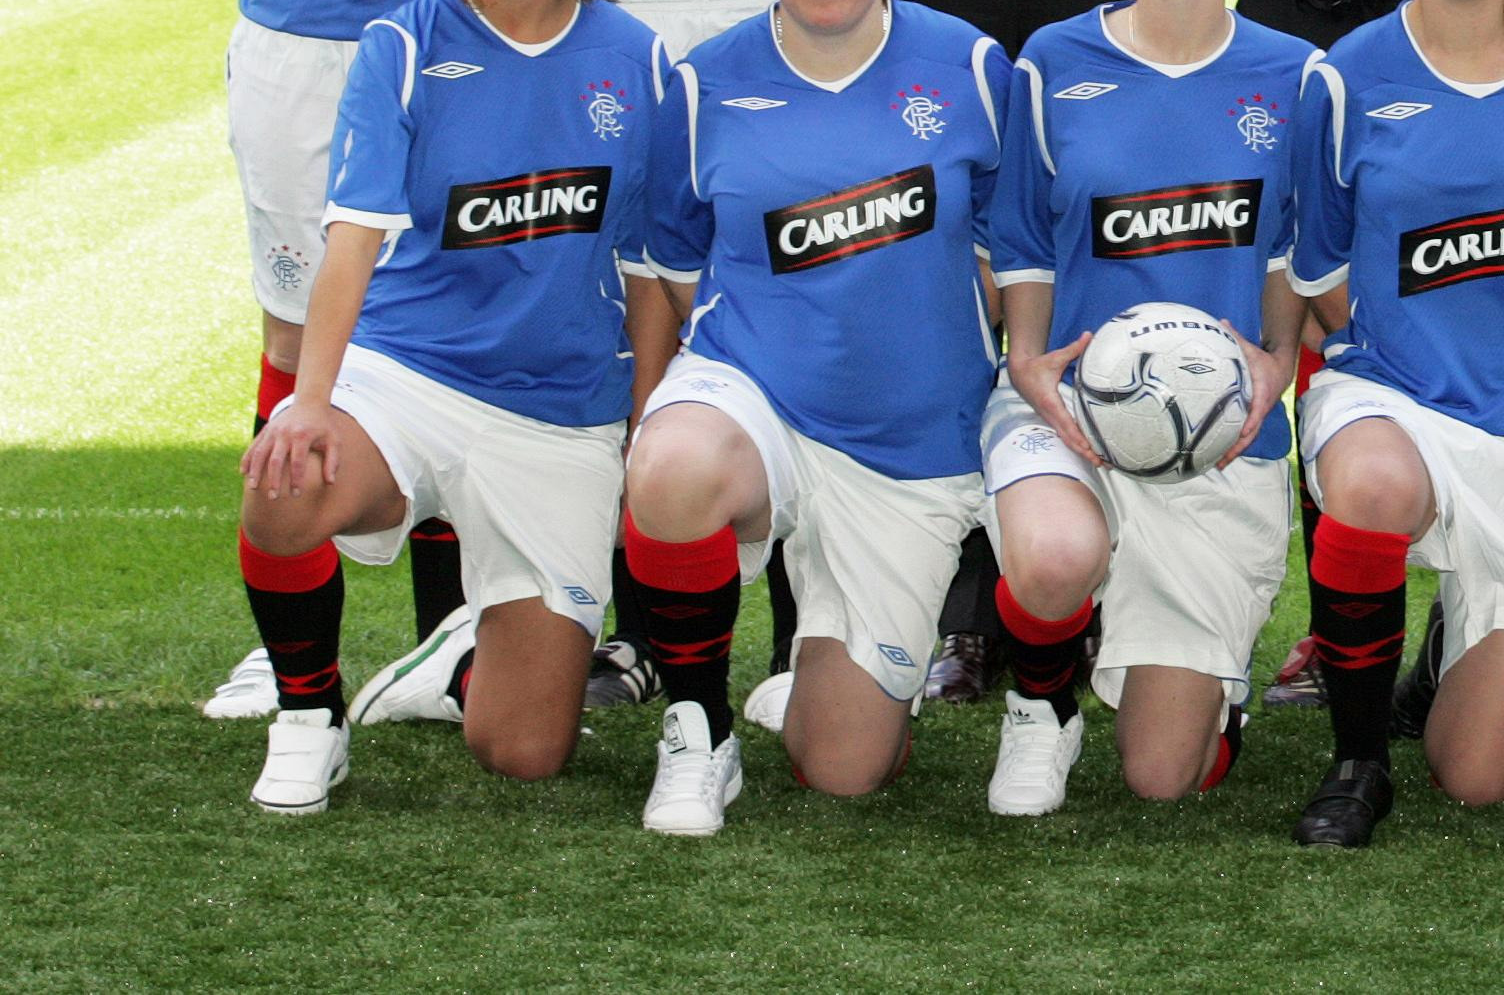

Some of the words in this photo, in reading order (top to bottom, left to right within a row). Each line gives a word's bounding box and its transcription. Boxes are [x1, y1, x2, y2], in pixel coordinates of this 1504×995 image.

[457, 185, 598, 233] CARLING
[779, 186, 925, 256] CARLING
[1103, 198, 1250, 243] CARLING
